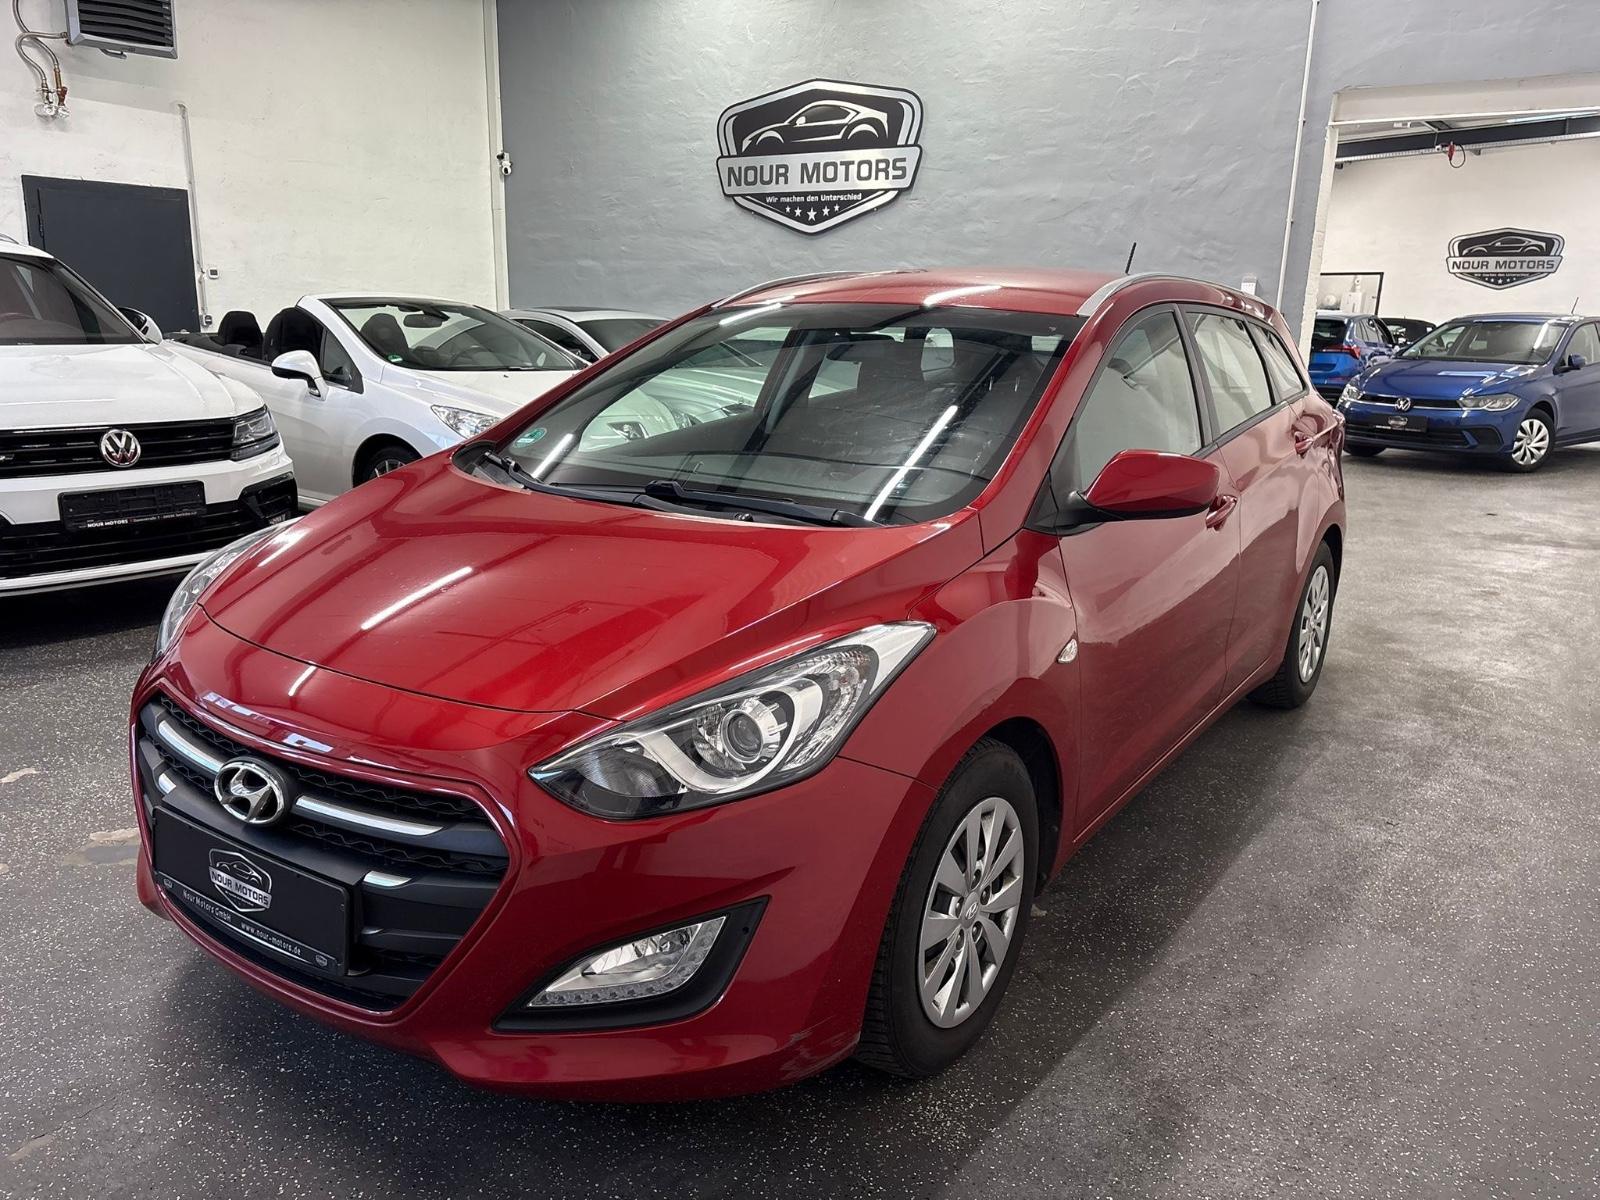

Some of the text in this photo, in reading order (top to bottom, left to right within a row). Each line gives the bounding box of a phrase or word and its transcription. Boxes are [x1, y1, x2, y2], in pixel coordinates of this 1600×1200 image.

[727, 157, 907, 187] NOUR MOTORS
[780, 195, 805, 203] machen
[820, 193, 862, 202] Unterschied
[1452, 260, 1555, 270] NOUR MOTORS
[211, 870, 232, 889] NOUR
[234, 881, 269, 907] MOTORS
[215, 907, 232, 922] GmbH
[241, 921, 301, 956] www.nour-motors.de
